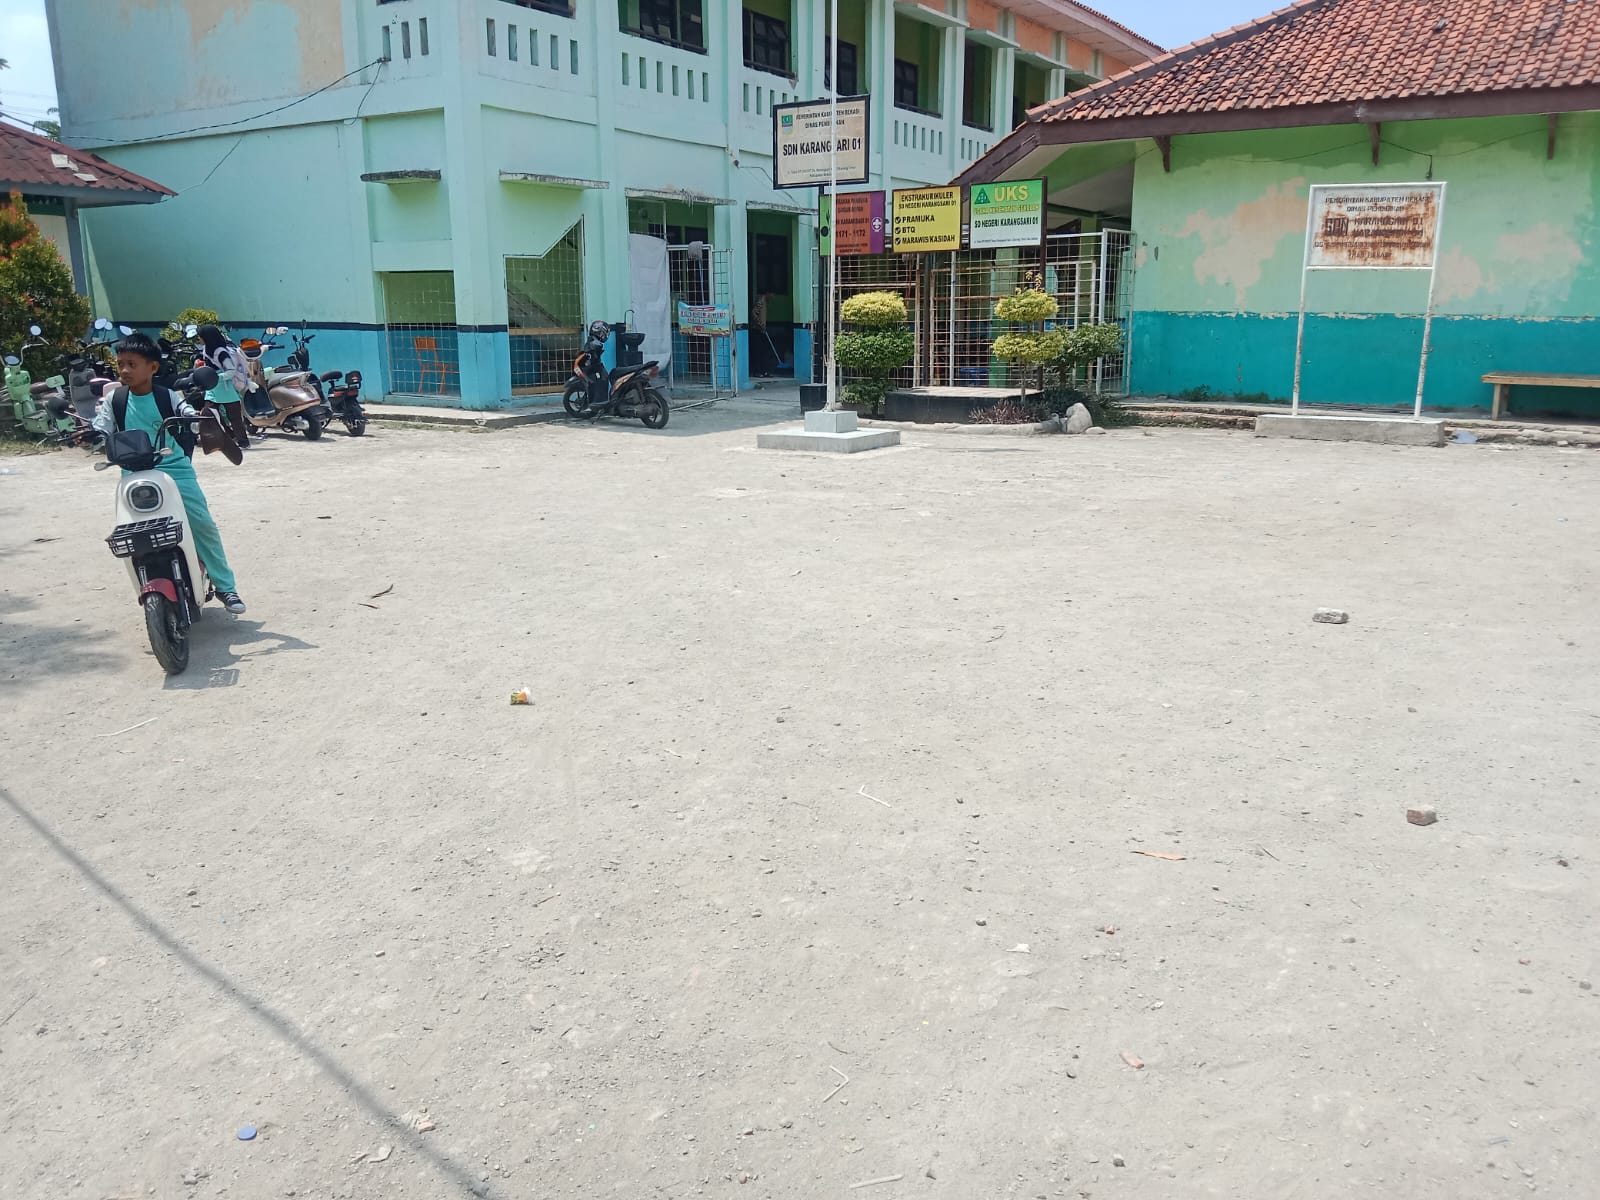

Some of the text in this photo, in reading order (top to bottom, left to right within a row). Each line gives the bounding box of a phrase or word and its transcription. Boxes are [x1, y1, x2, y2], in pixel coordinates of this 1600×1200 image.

[783, 138, 861, 156] SDN KARANGARI 01
[901, 192, 953, 202] EKSTRAKURIKULER
[994, 185, 1028, 202] UKS
[922, 200, 950, 208] KARANGSARI
[902, 214, 935, 223] PRAMUKA
[975, 220, 981, 228] SD
[982, 219, 999, 227] NEGERI
[1001, 217, 1031, 226] KARANGSARI
